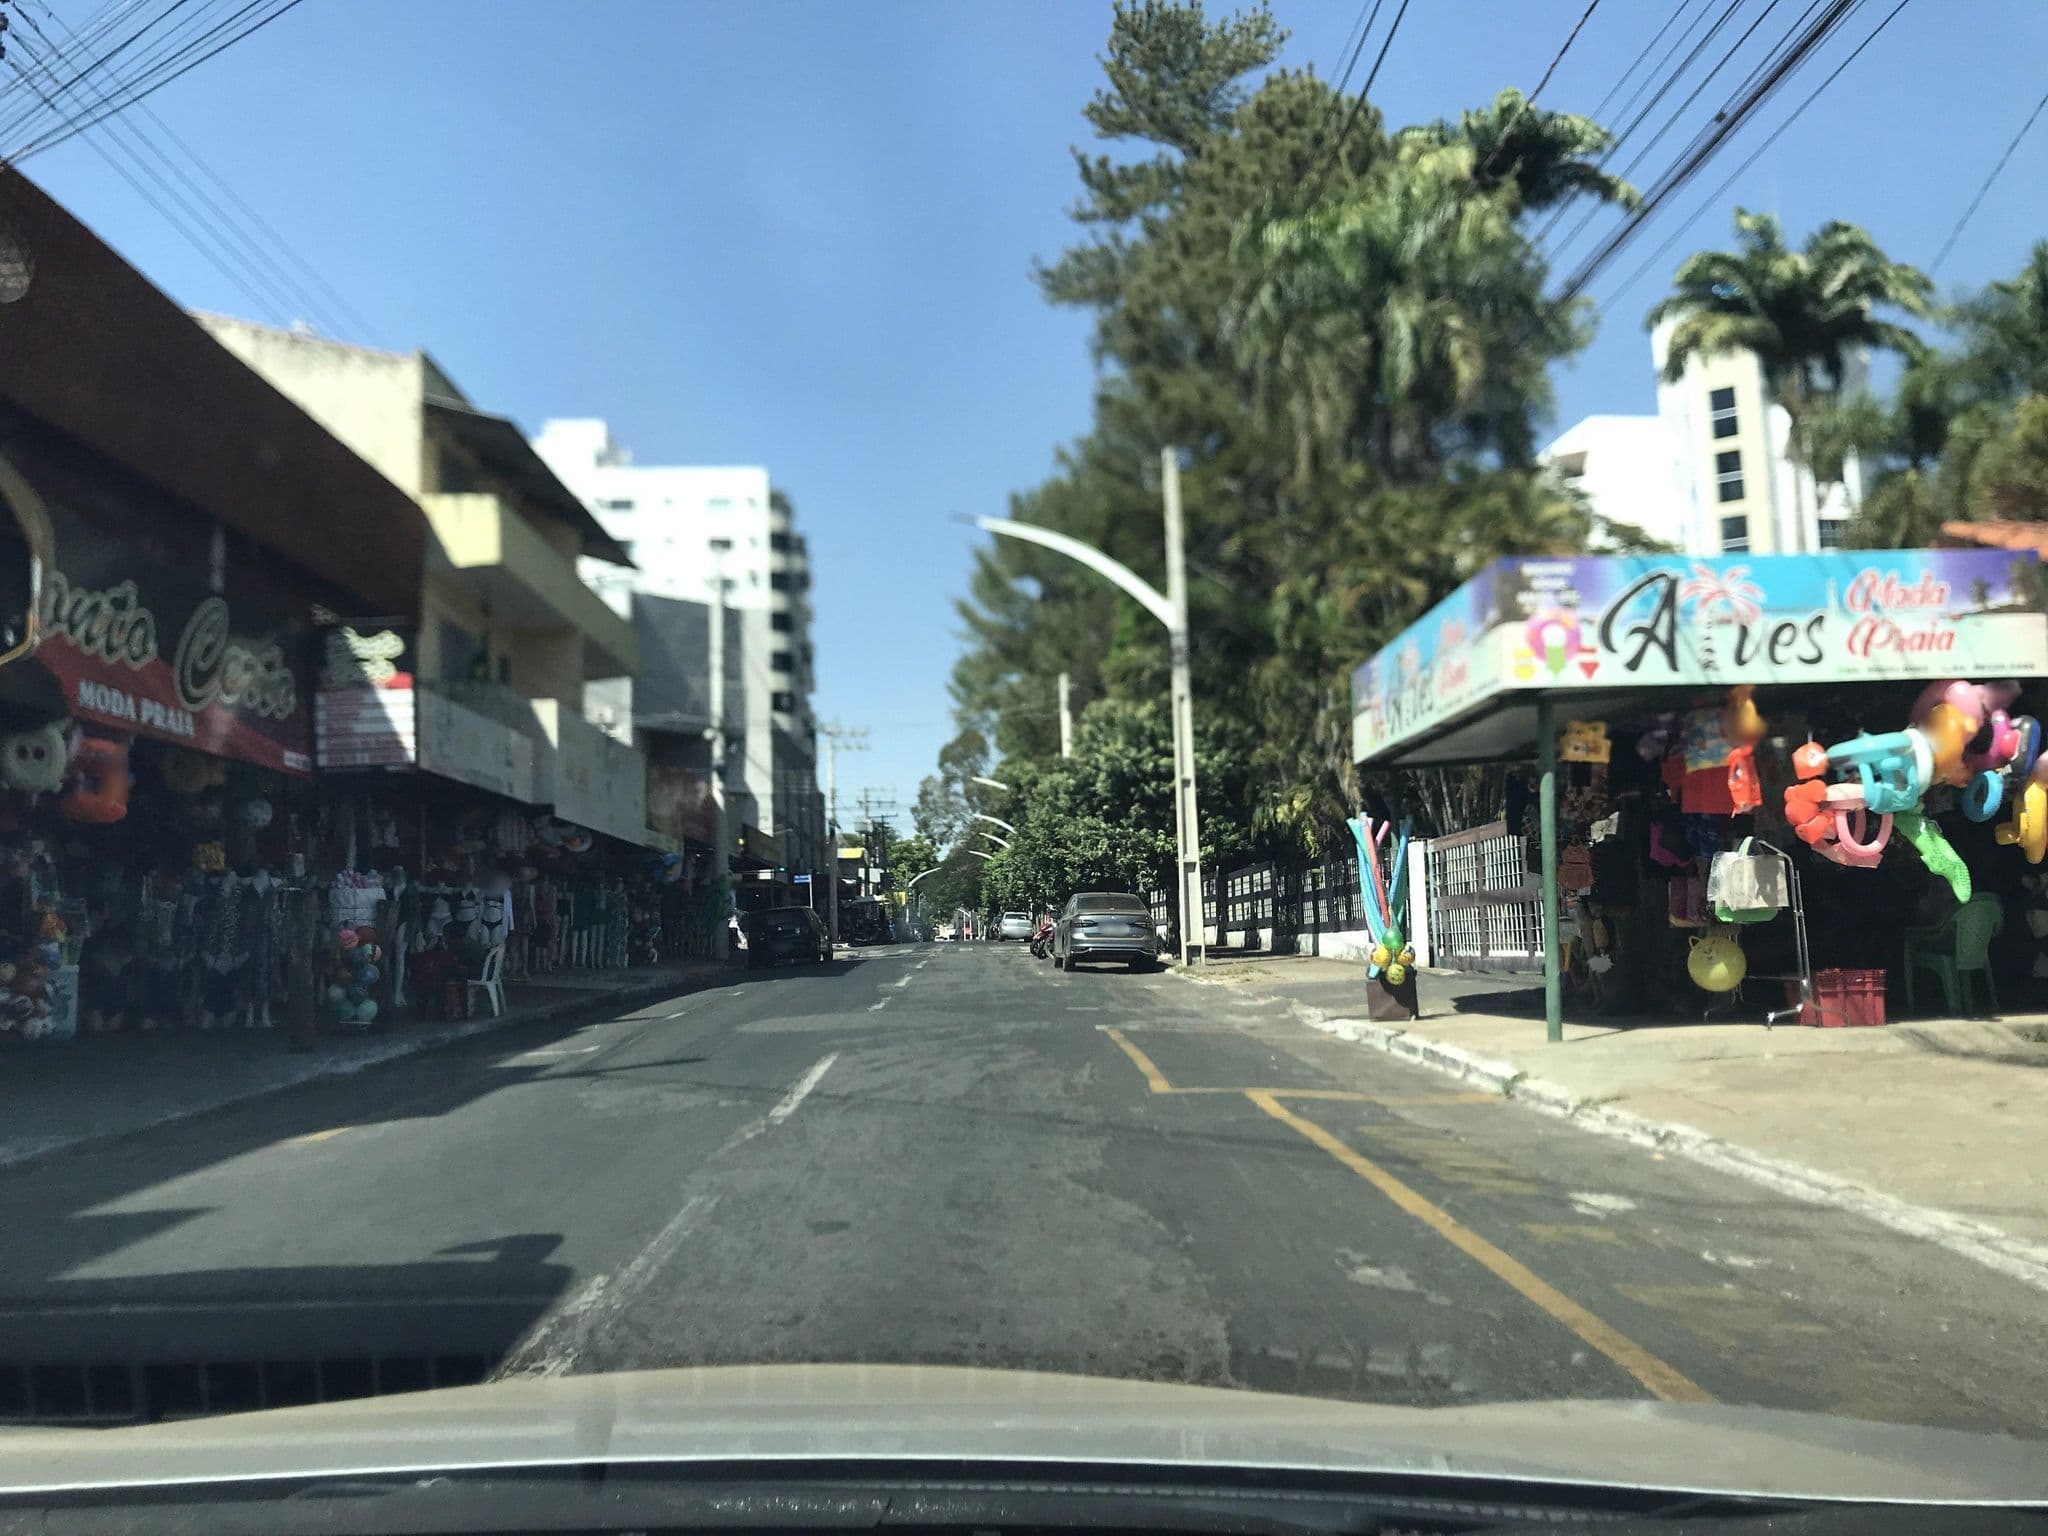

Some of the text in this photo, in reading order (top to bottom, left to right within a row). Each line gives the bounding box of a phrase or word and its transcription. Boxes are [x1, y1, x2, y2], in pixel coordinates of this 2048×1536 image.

[1847, 569, 1949, 612] Moda
[1847, 614, 1956, 658] Praia
[78, 679, 195, 739] MODA PRAIA
